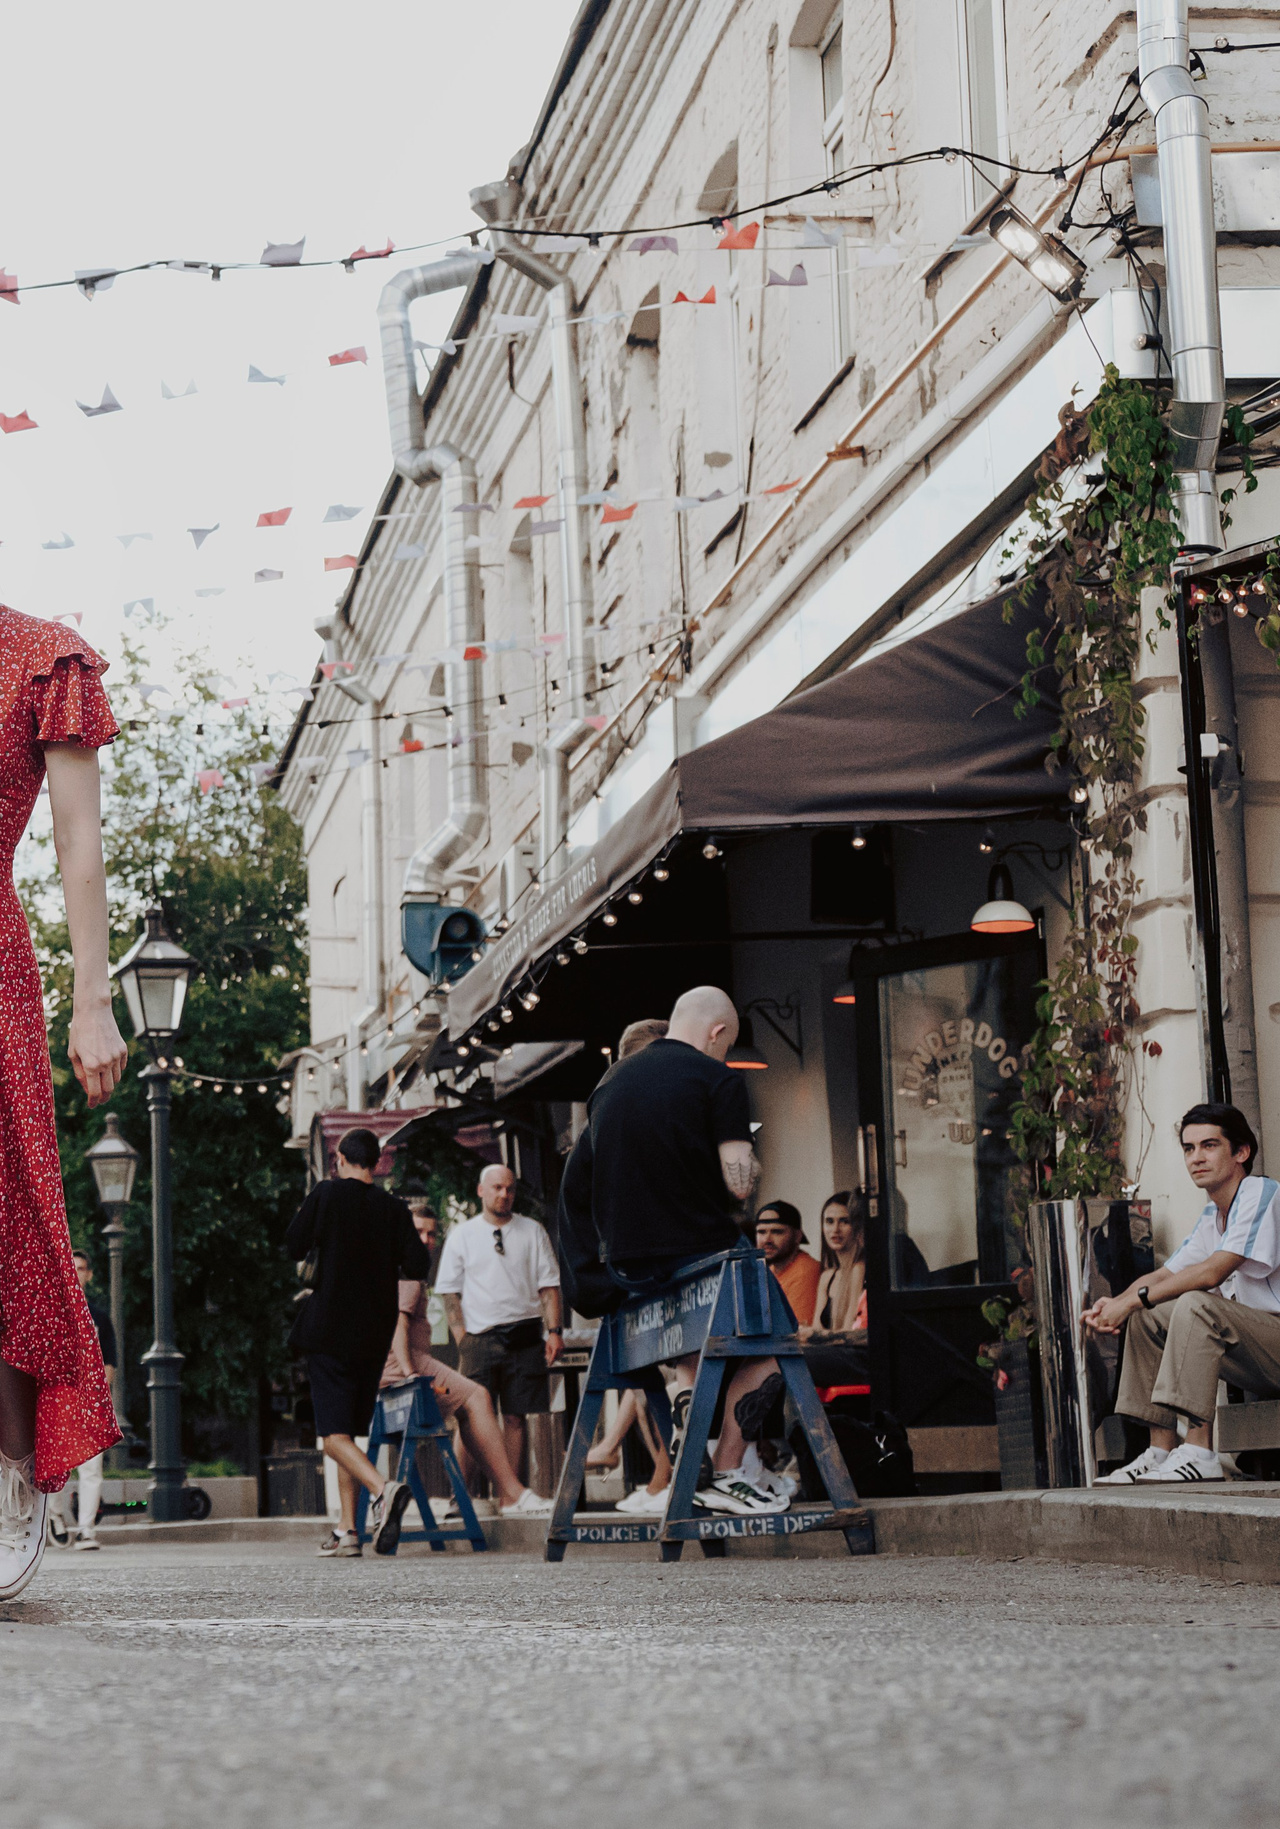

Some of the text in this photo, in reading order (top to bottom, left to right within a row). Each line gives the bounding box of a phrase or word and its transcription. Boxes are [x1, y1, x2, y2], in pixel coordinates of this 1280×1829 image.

[552, 885, 567, 919] FOR
[568, 857, 597, 904] LOCALS
[576, 1526, 640, 1541] POLICE
[699, 1517, 776, 1539] POLICE
